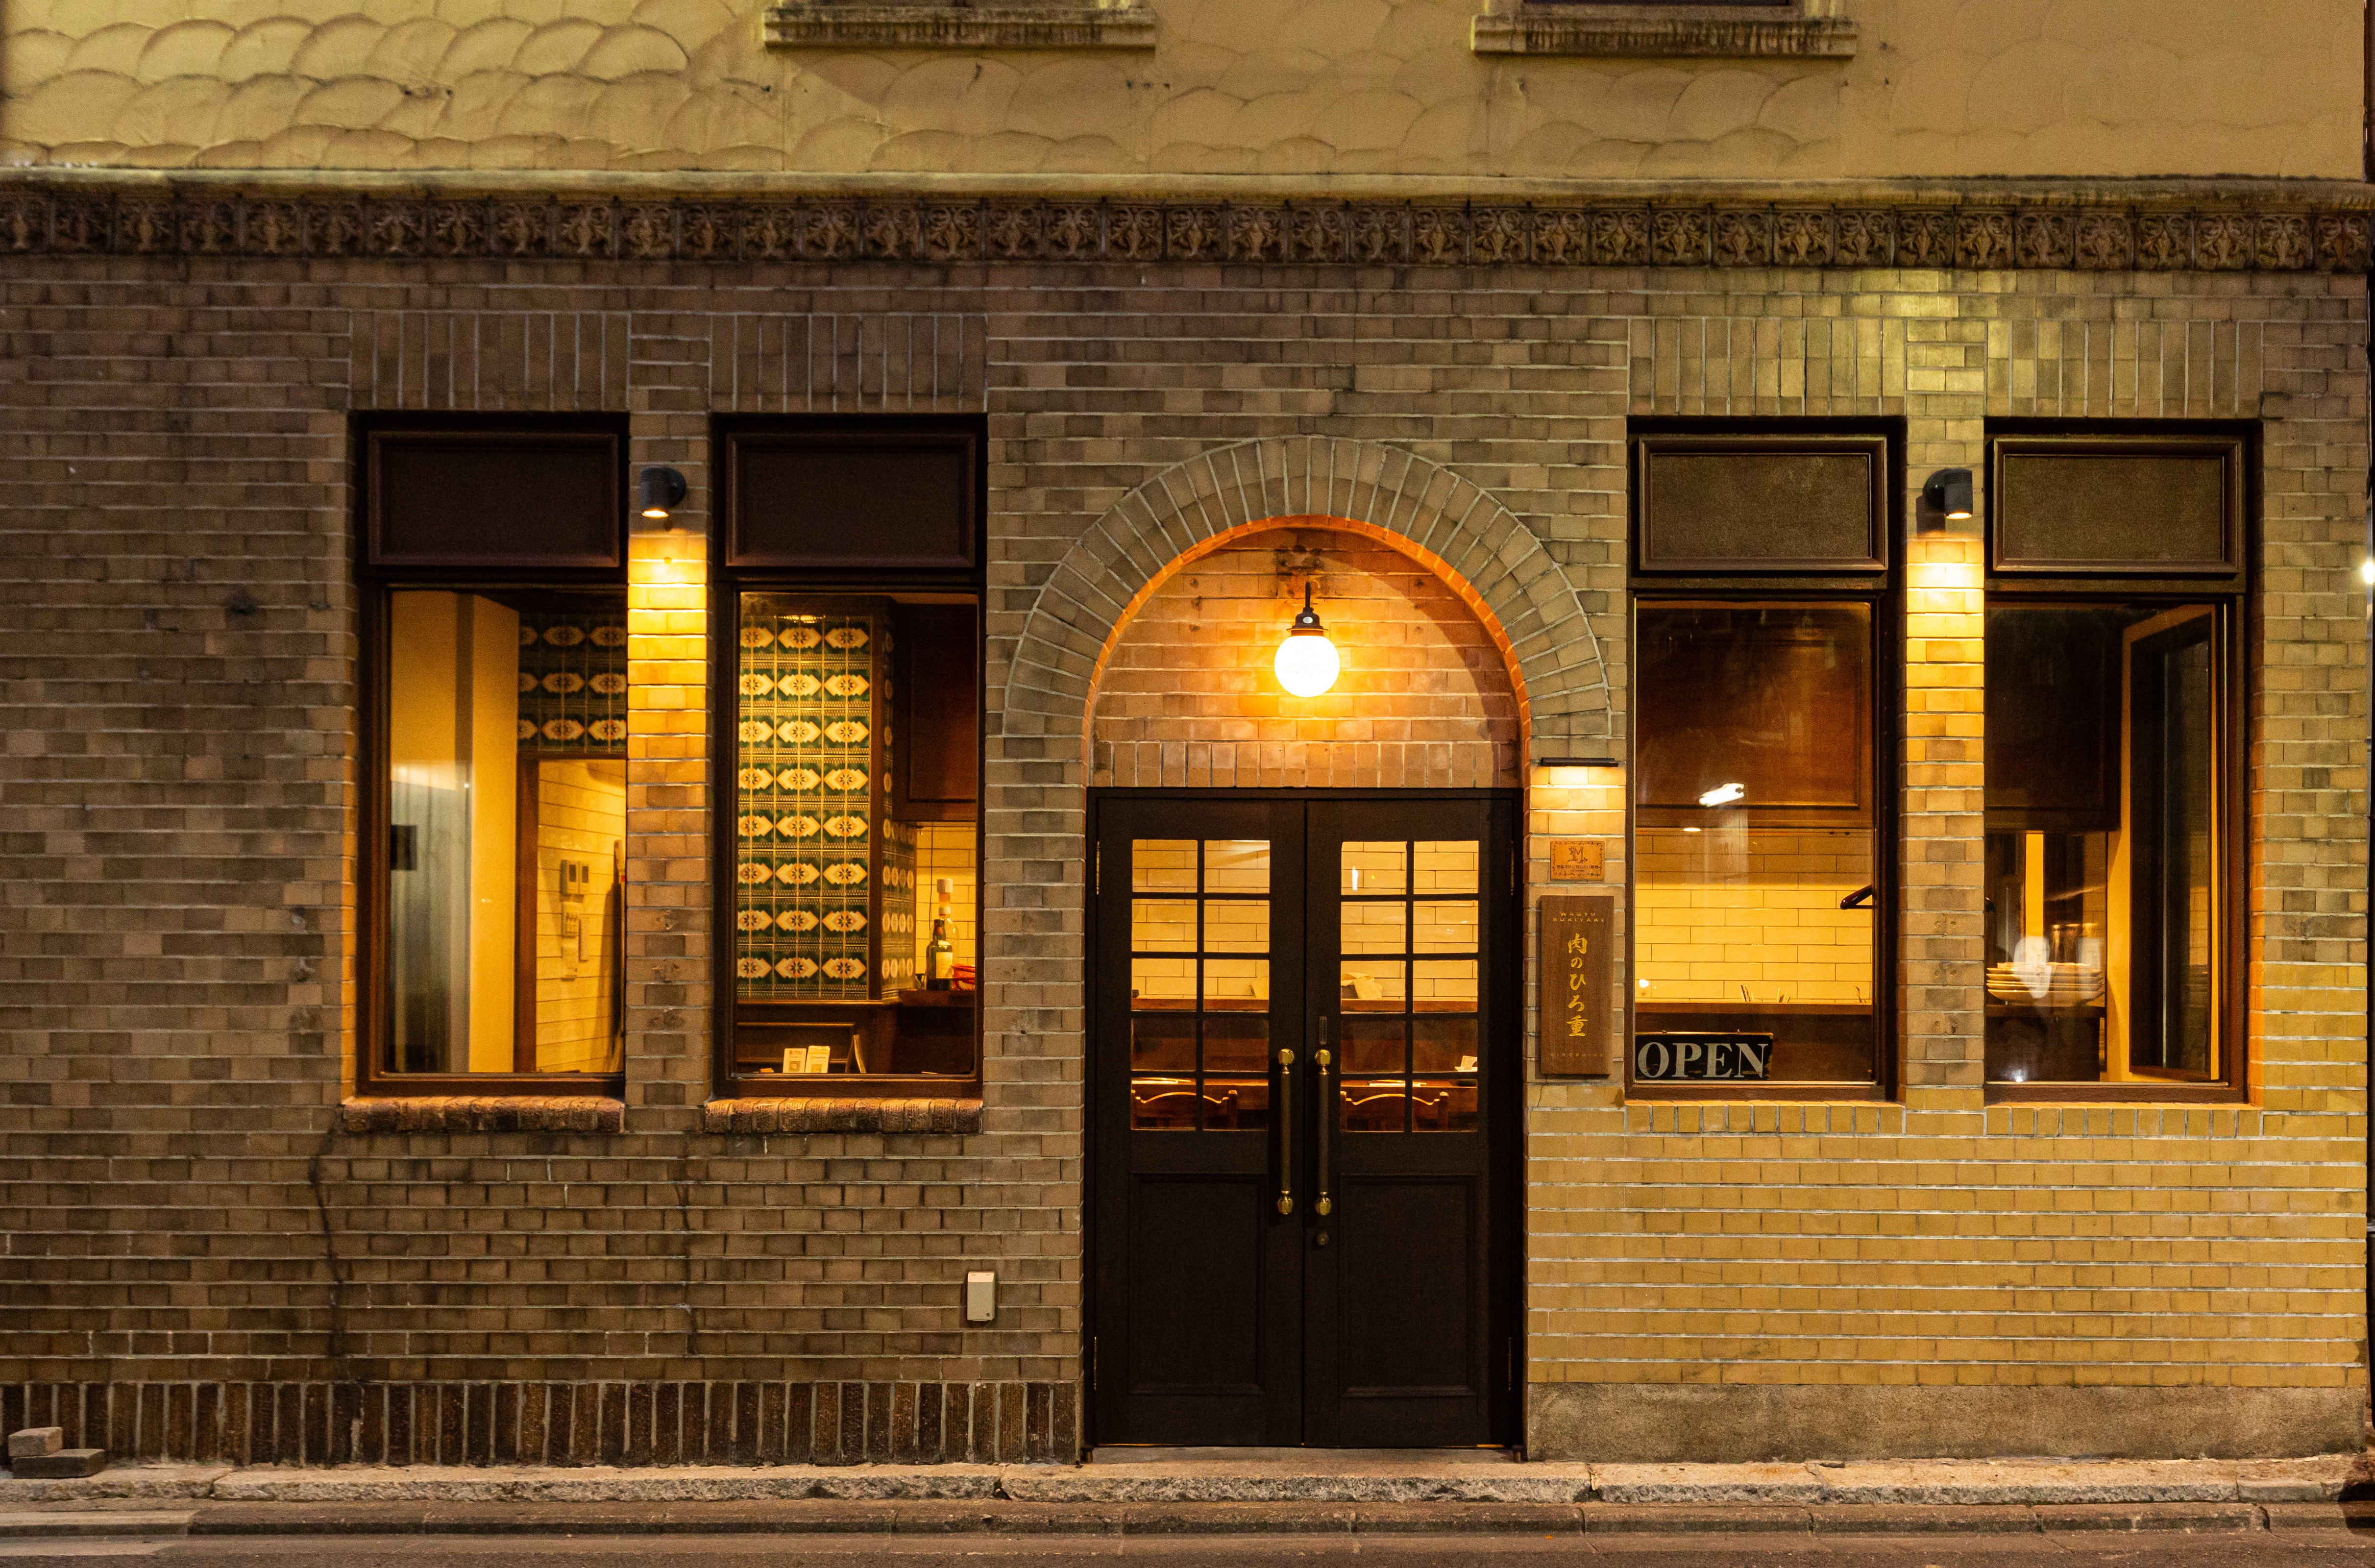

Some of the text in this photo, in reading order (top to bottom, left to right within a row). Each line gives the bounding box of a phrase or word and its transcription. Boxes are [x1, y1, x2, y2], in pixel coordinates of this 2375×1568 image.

[1567, 933, 1588, 1036] 肉のひろ重
[1638, 1042, 1768, 1078] OPEN
